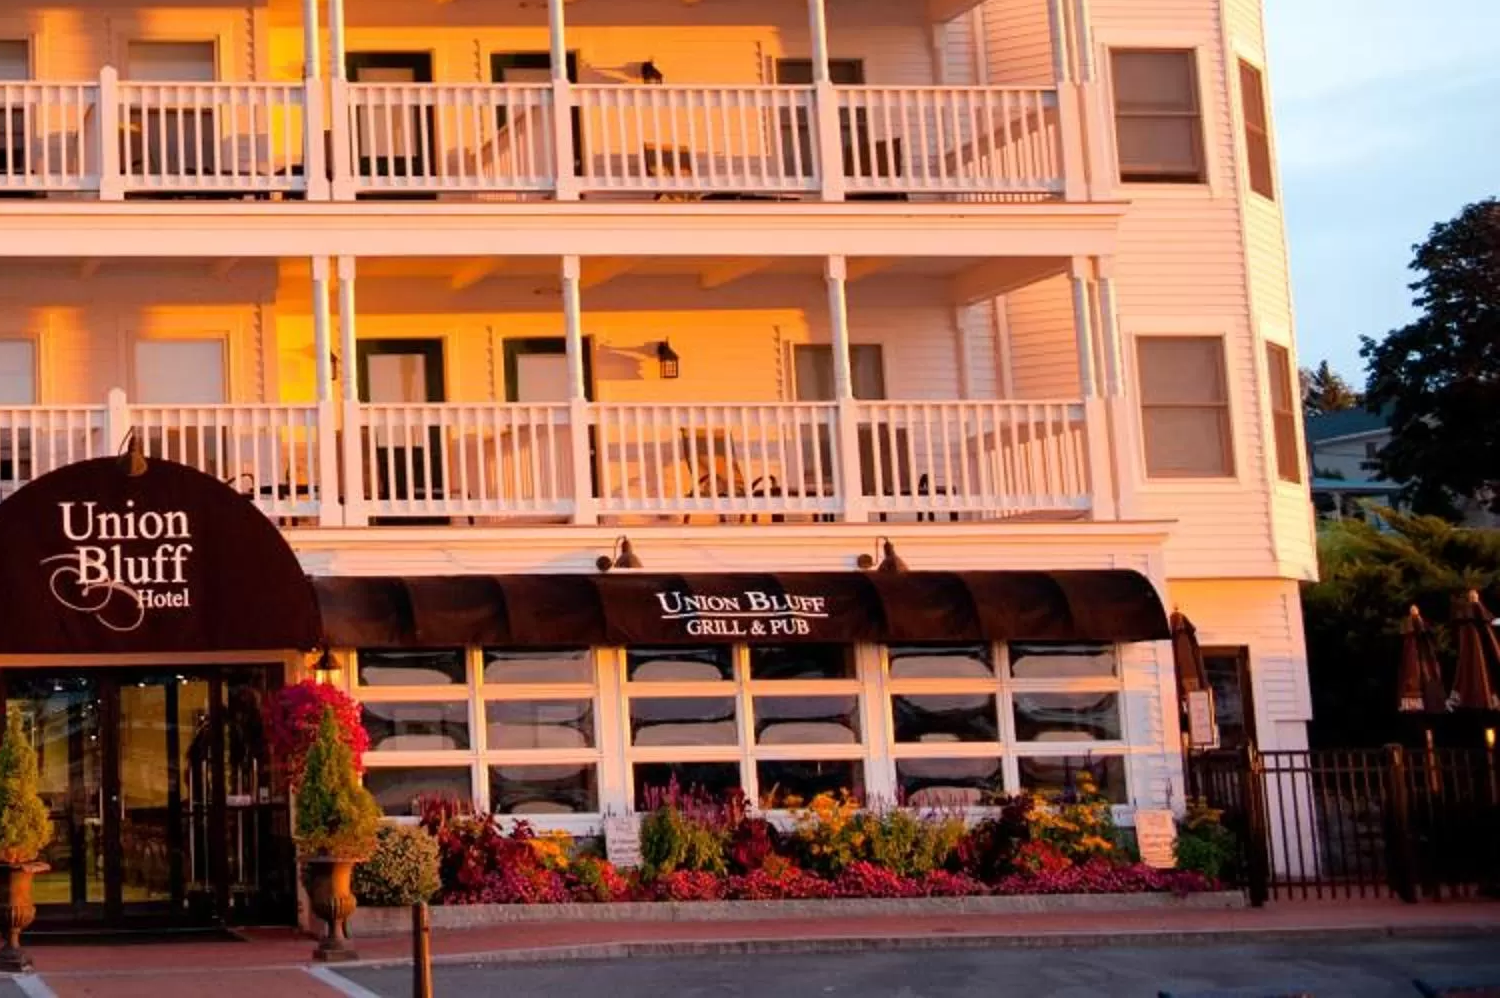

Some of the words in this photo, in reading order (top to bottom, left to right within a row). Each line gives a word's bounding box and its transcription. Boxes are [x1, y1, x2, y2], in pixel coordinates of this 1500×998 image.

[58, 500, 192, 541] Union
[74, 543, 194, 584] Bluff
[136, 588, 190, 609] Hotel
[655, 591, 741, 613] UNION
[744, 591, 825, 612] BLUFF
[686, 619, 747, 635] GRILL
[751, 620, 766, 635] &
[770, 619, 810, 635] PUB
